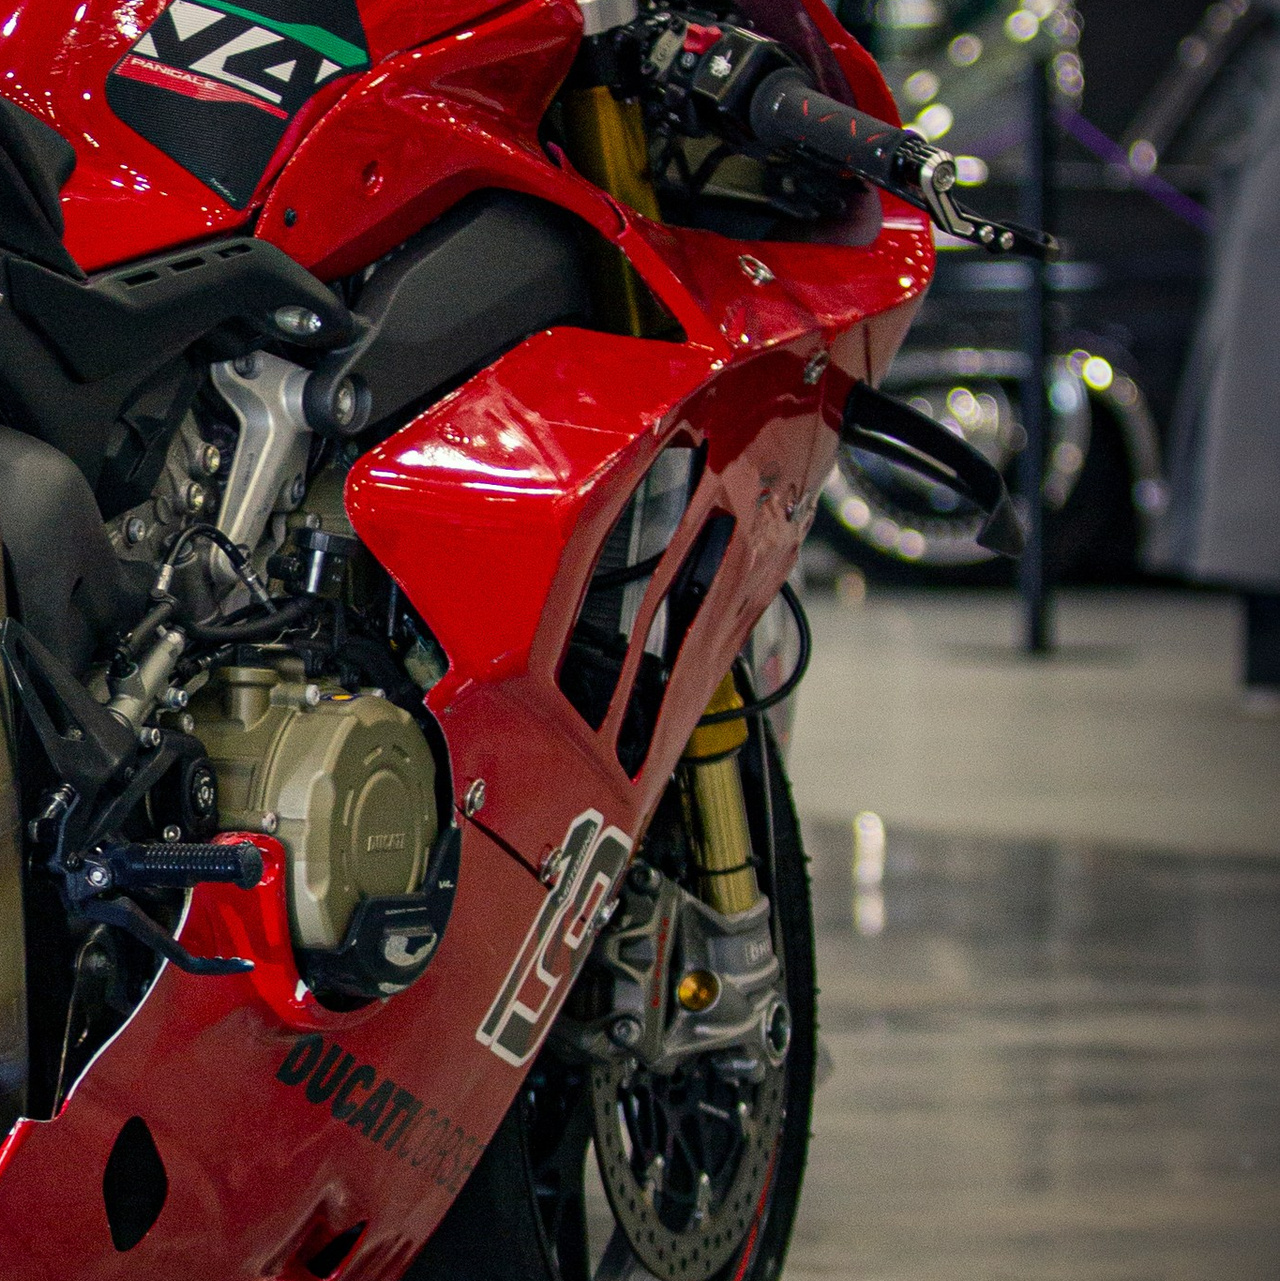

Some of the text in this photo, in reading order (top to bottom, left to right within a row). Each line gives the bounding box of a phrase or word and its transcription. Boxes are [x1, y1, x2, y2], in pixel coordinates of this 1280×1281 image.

[130, 57, 220, 91] PANIGALE
[136, 0, 338, 105] V4
[276, 1033, 423, 1151] DUCATI
